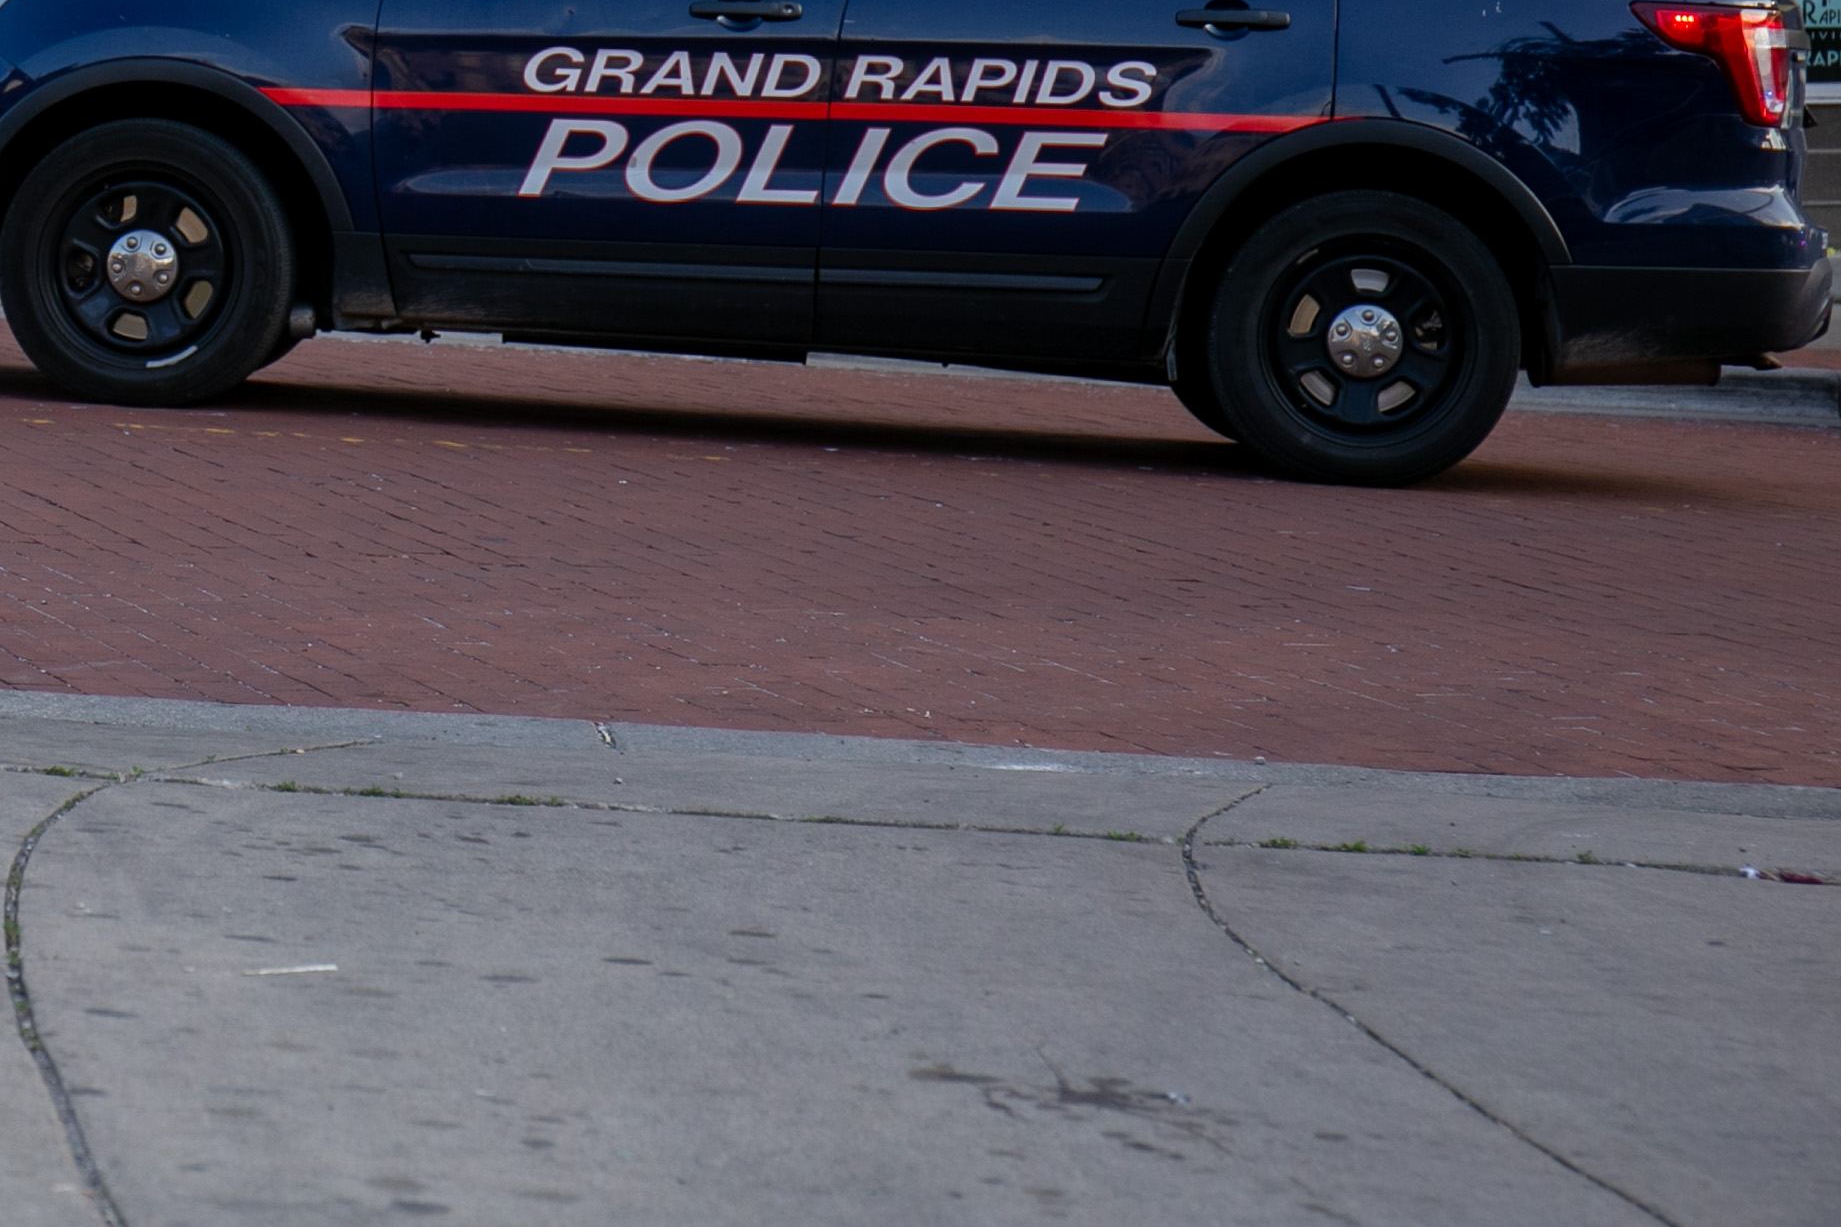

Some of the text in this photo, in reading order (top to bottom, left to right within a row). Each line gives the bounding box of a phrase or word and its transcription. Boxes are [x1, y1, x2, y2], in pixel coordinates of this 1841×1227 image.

[522, 46, 1158, 108] GRAND RAPIDS
[517, 117, 1109, 213] POLICE
